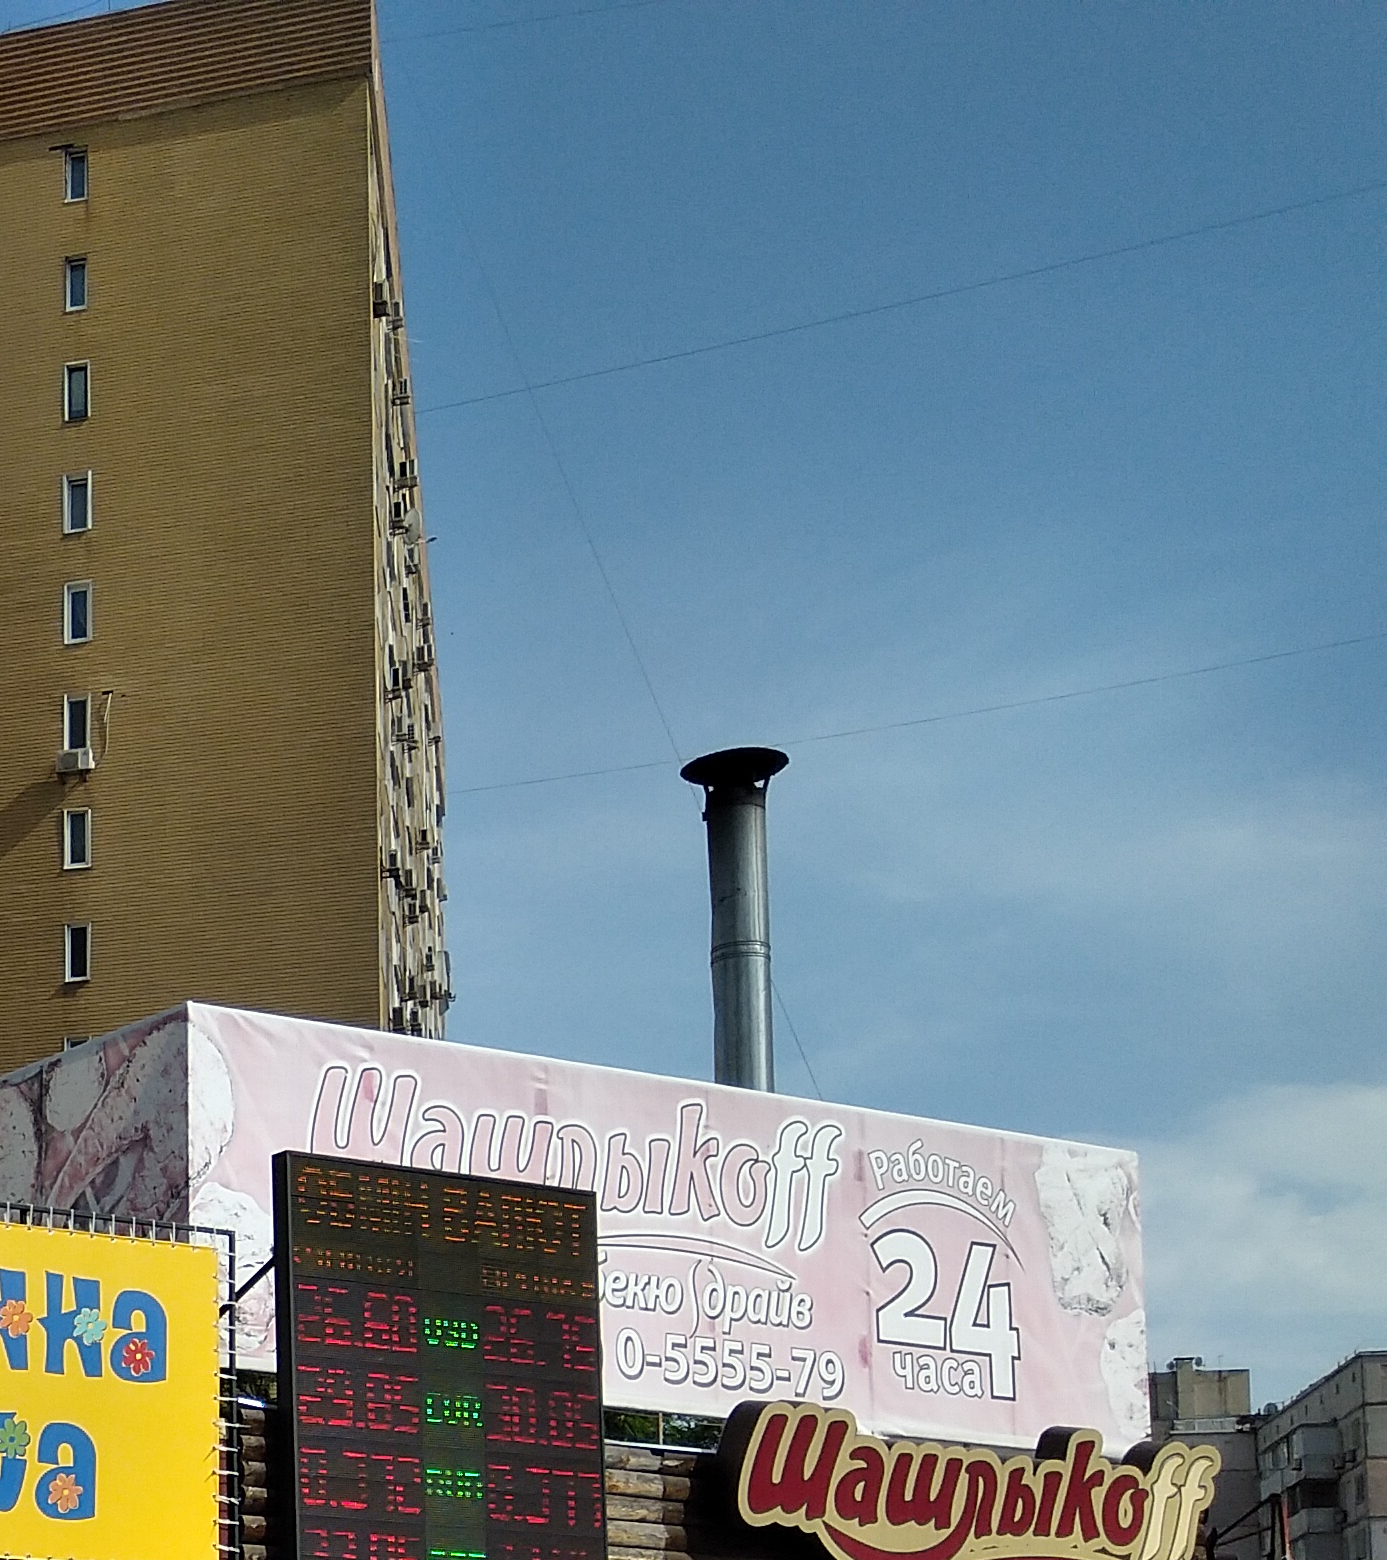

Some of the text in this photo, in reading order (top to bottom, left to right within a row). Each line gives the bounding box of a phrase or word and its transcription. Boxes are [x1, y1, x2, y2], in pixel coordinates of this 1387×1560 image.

[867, 1138, 1017, 1228] Работаем
[702, 1261, 814, 1335] драйв
[869, 1227, 1022, 1402] 24
[615, 1326, 845, 1401] 0-5555-79
[891, 1350, 985, 1399] часа
